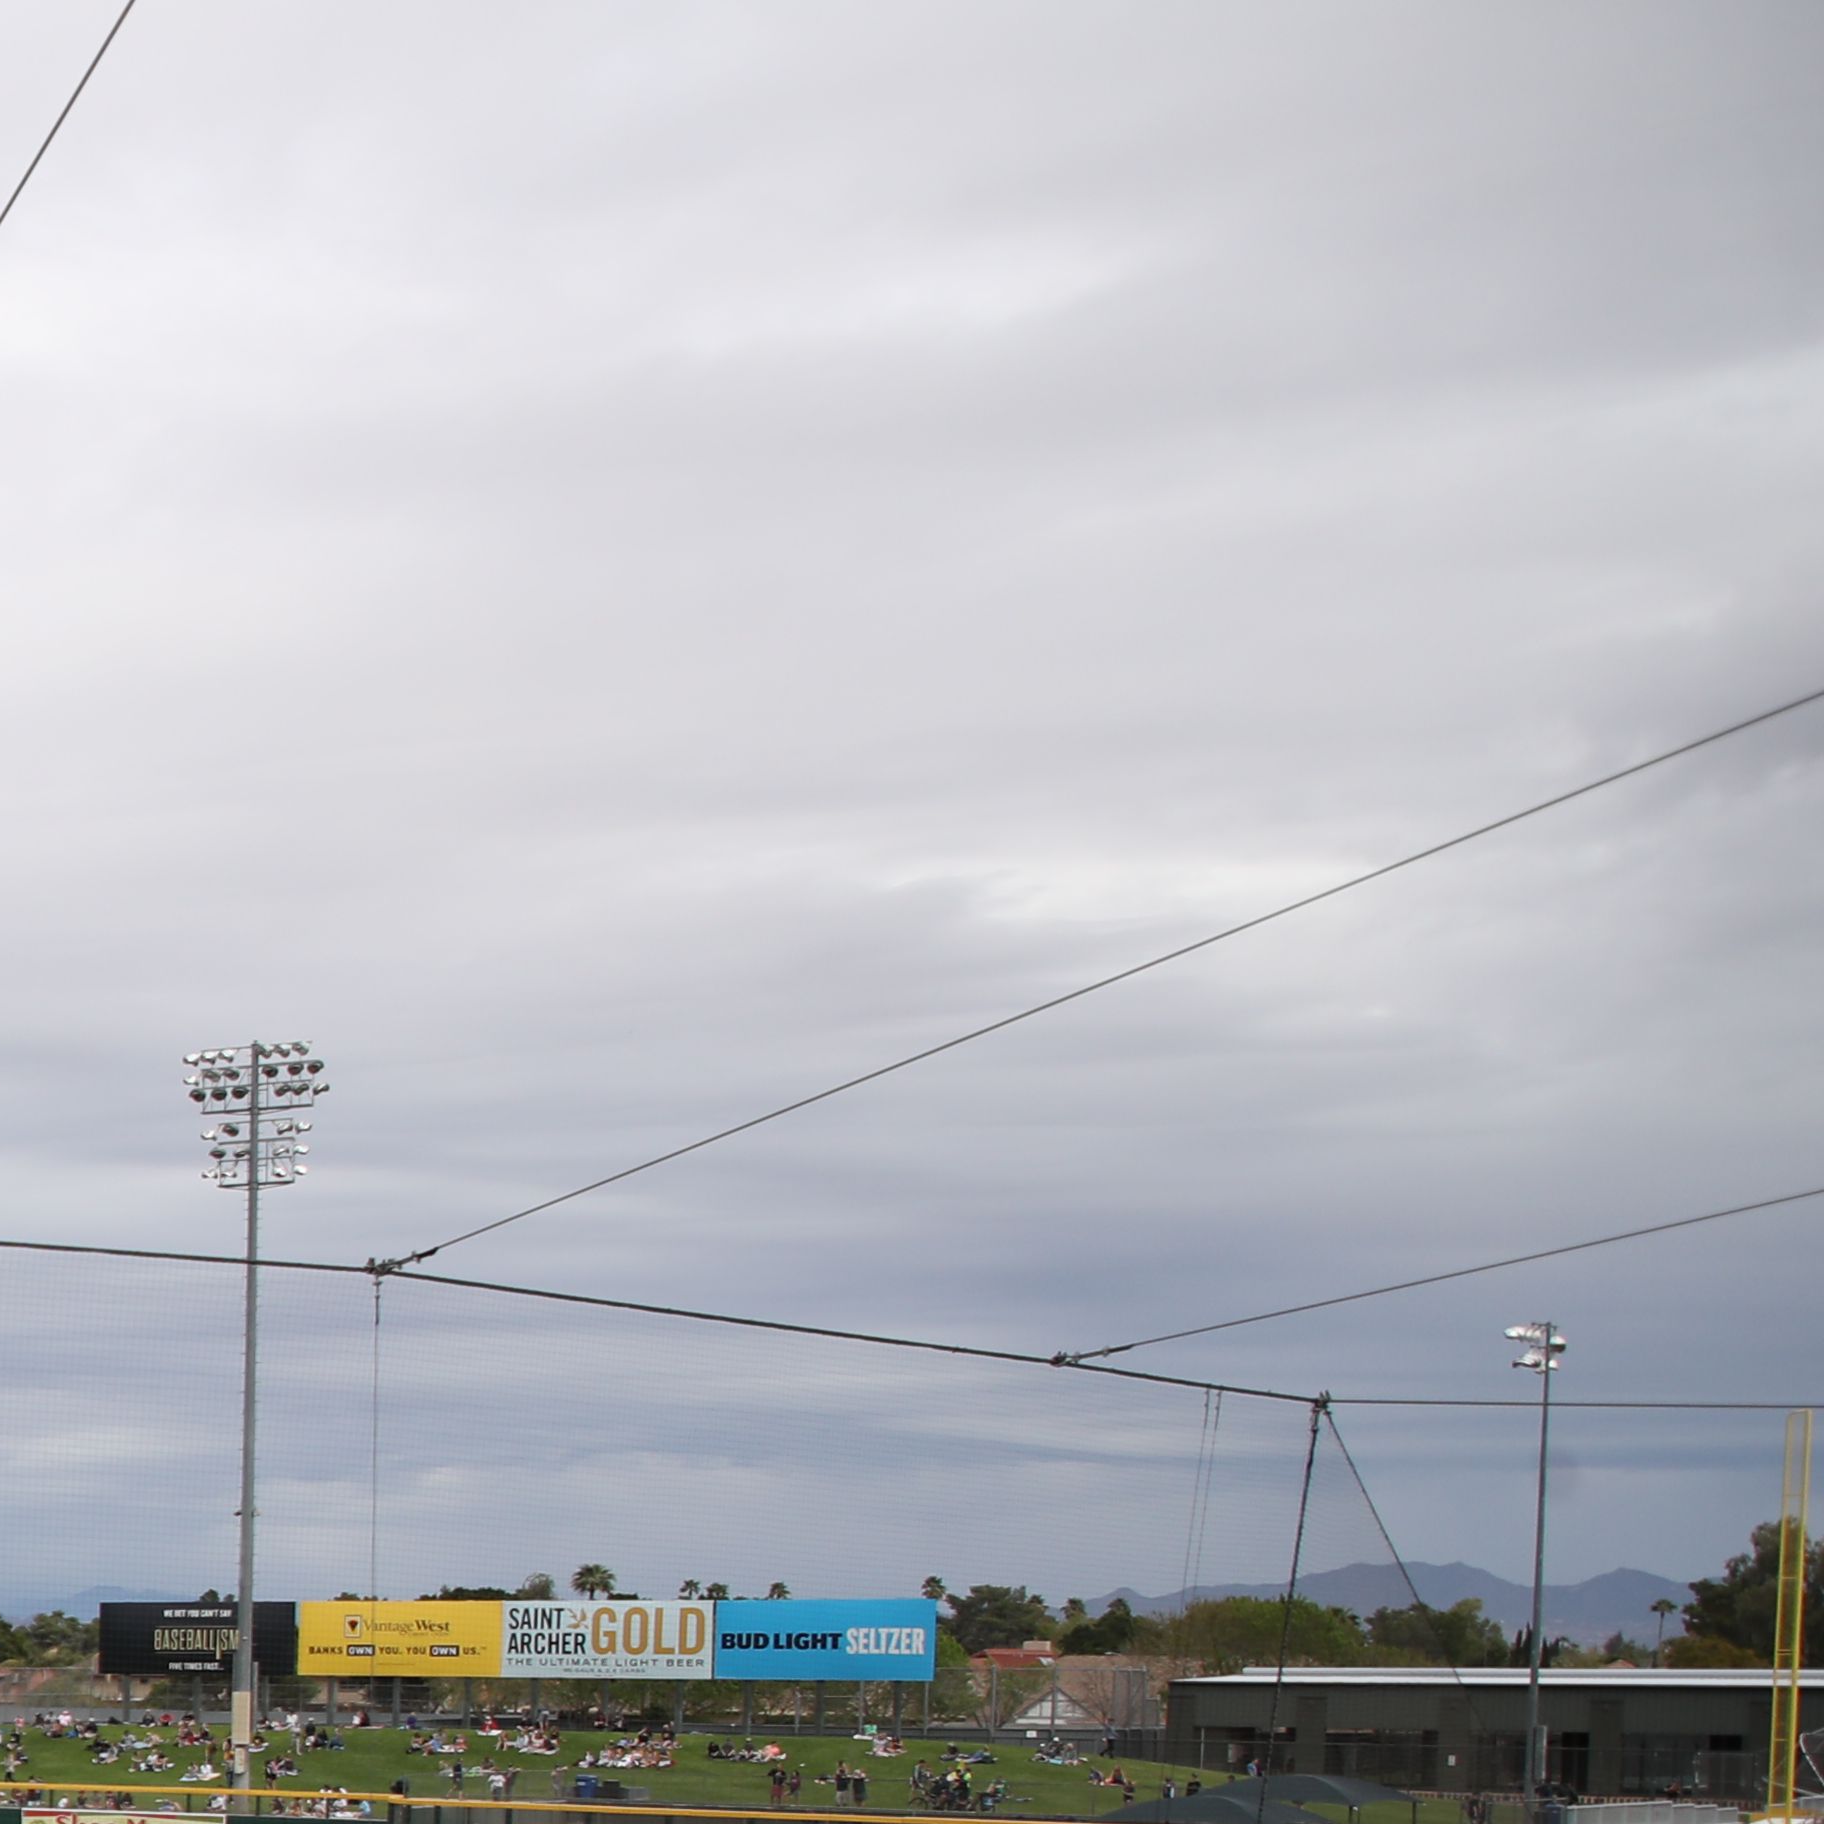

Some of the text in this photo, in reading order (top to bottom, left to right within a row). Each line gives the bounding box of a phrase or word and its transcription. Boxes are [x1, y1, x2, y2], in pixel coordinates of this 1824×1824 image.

[163, 1609, 173, 1617] WE
[187, 1609, 200, 1617] YOU
[200, 1609, 218, 1617] CAN'T
[508, 1606, 706, 1655] SAINT GOLD
[154, 1628, 239, 1658] BASEBALLISM
[507, 1633, 586, 1655] ARCHER
[721, 1627, 925, 1655] BUD LIGHT SELTZER
[308, 1646, 342, 1655] BANKS
[348, 1646, 373, 1655] OWN
[406, 1647, 426, 1655] YOU
[431, 1647, 458, 1656] OWN
[169, 1662, 182, 1670] FIVE
[507, 1658, 704, 1667] THE ULTIMATE LIGHT BEER
